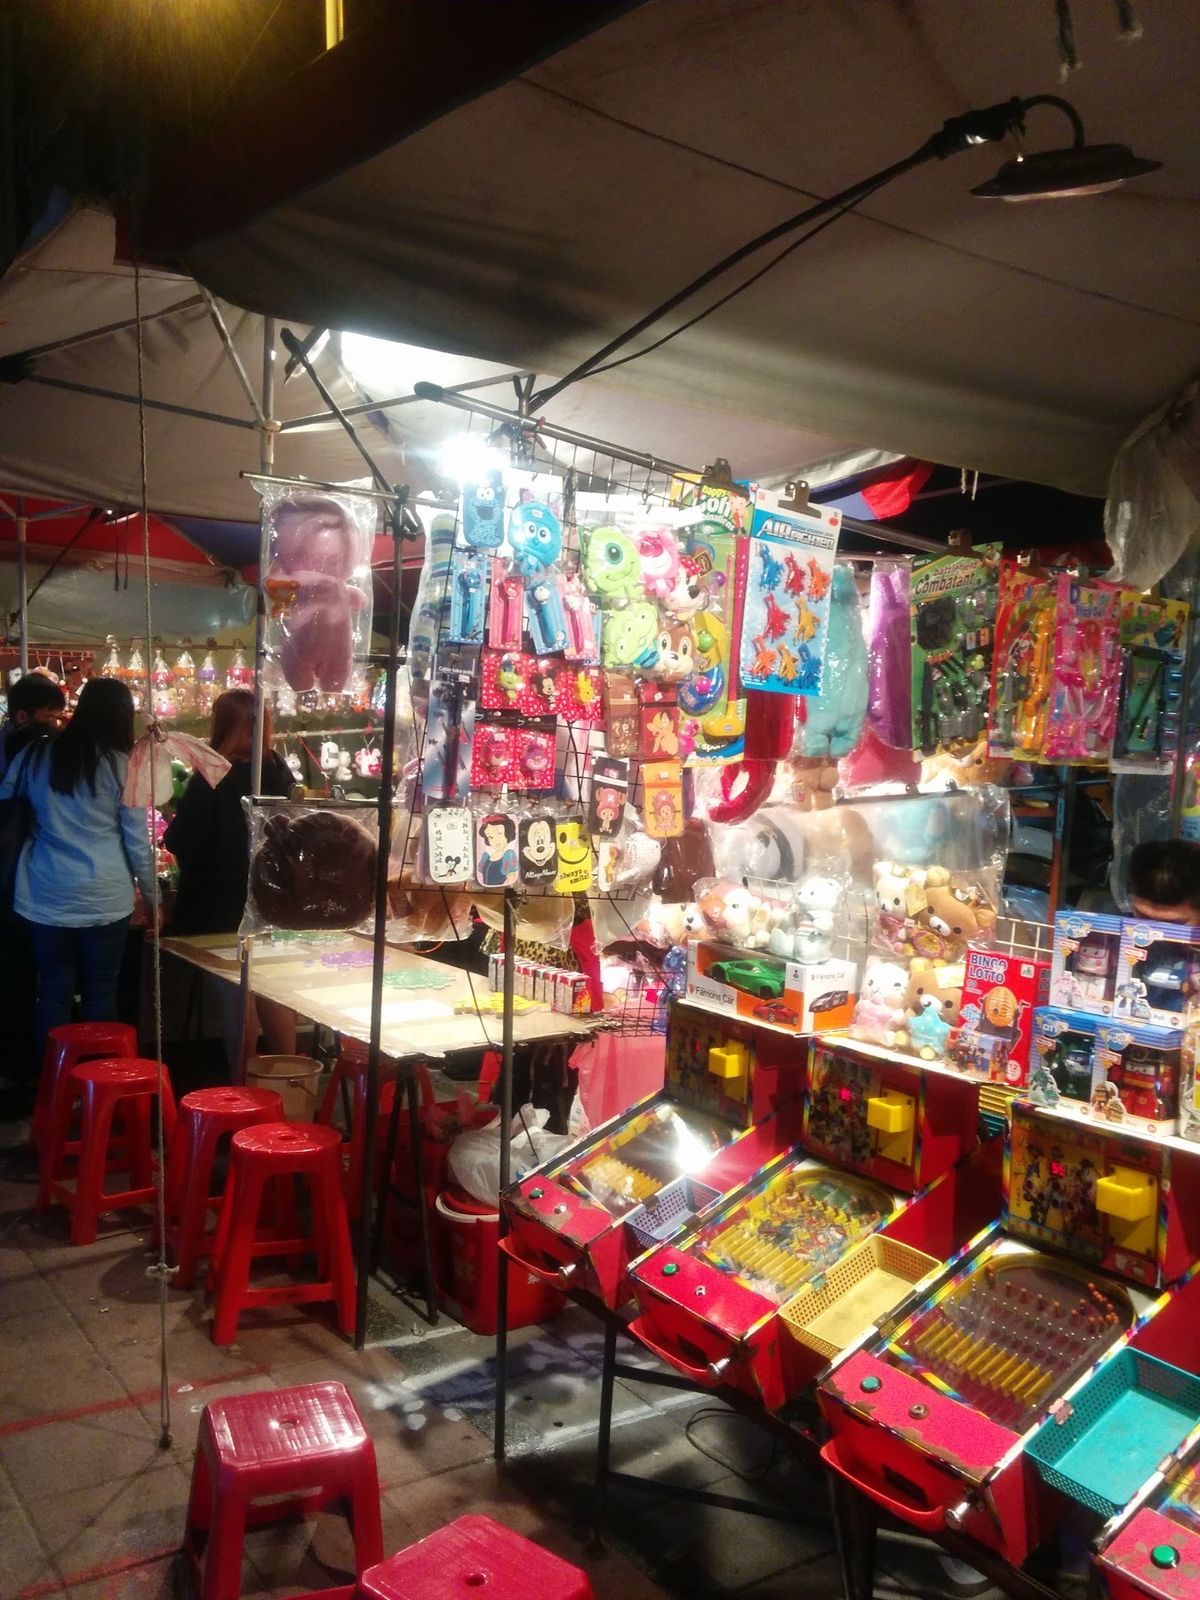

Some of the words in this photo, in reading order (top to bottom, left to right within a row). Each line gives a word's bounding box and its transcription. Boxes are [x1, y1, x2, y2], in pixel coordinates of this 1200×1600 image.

[915, 572, 975, 595] Combatant
[971, 954, 1007, 971] BINGO
[969, 966, 1004, 983] LOTTO
[722, 993, 735, 1005] Car
